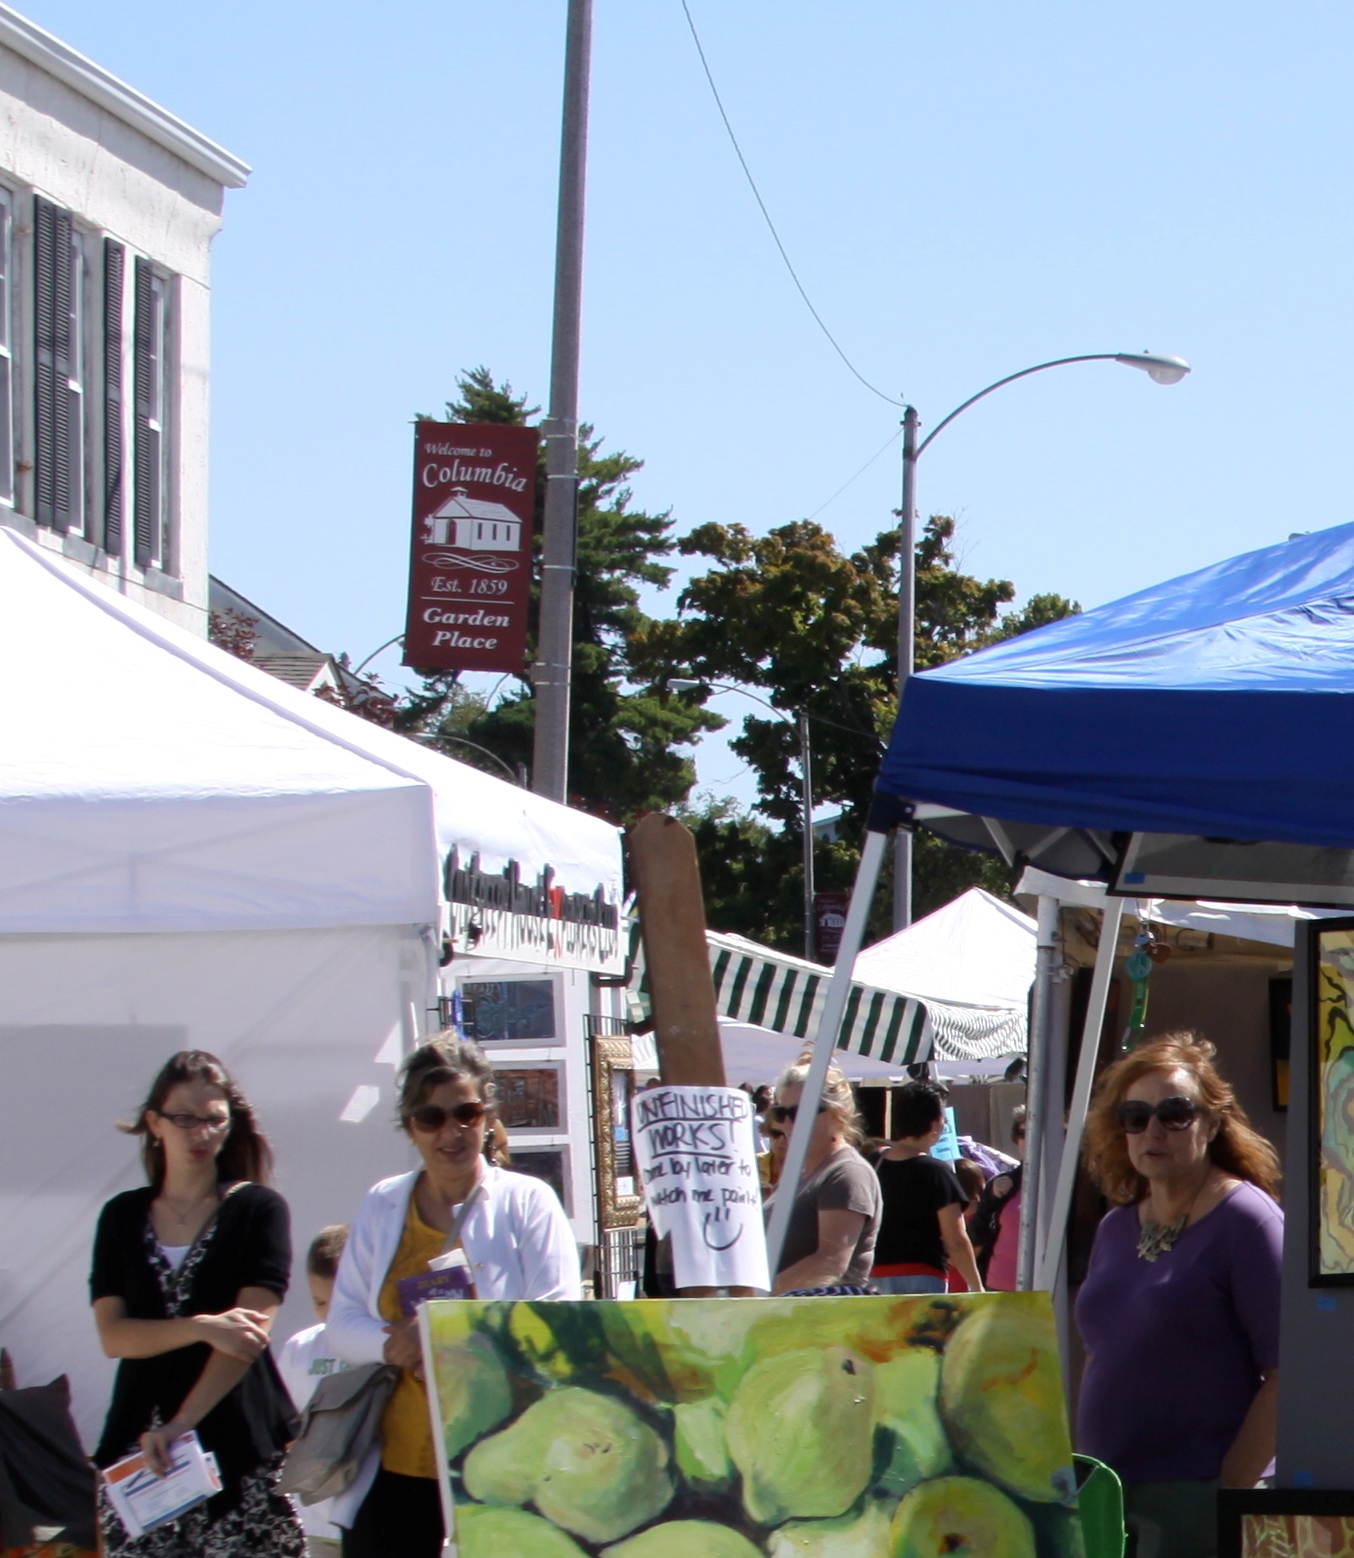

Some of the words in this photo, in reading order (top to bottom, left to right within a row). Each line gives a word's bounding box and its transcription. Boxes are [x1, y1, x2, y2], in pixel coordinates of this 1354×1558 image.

[424, 442, 477, 457] Welcome
[479, 446, 492, 457] to
[422, 459, 527, 492] Columbia
[431, 577, 462, 593] Est.
[469, 579, 508, 595] 1859
[423, 607, 510, 627] Garden
[432, 631, 498, 650] Place
[639, 1091, 748, 1123] UNFINISHED
[649, 1121, 738, 1154] WORKS!
[670, 1158, 691, 1180] by
[738, 1160, 752, 1176] to
[691, 1189, 715, 1202] me
